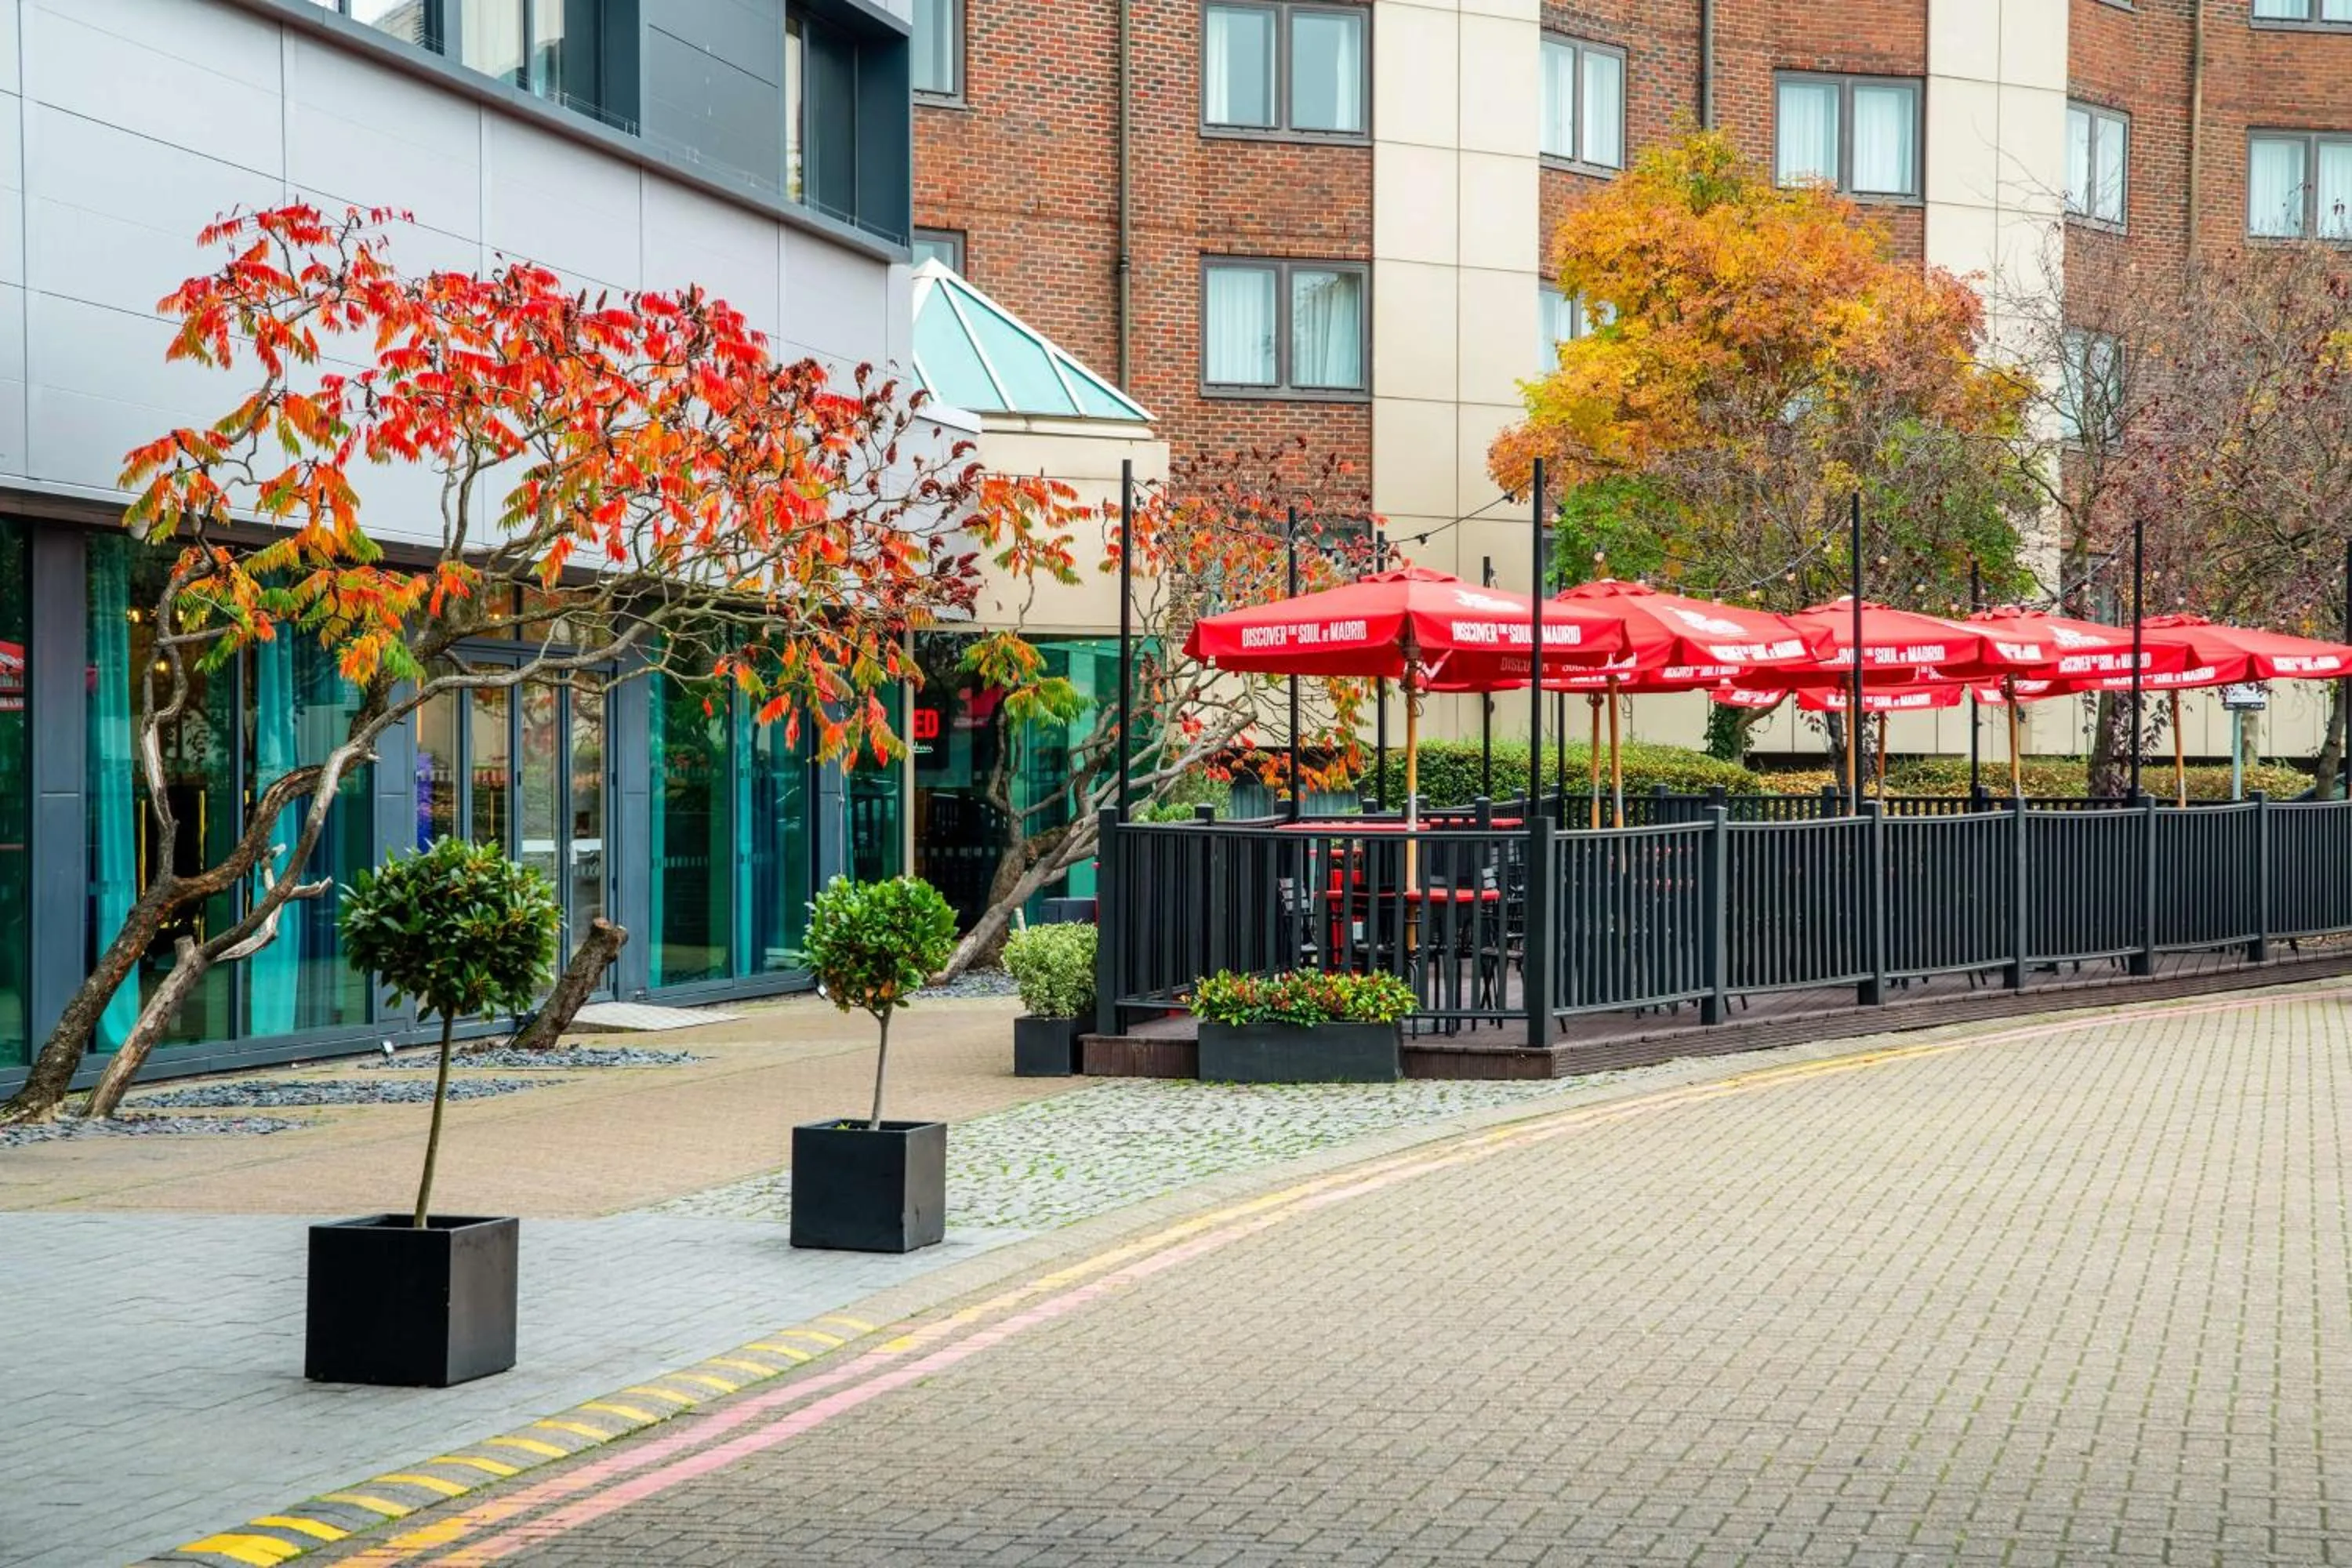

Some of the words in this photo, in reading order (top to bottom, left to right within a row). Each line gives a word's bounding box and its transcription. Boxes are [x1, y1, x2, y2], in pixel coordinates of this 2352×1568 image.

[1242, 625, 1287, 648] DISCOVER
[1298, 622, 1321, 644] SOUL
[1330, 620, 1367, 641] MADRID
[1451, 621, 1499, 644] DISCOVER
[1508, 623, 1535, 644] SOUL
[1542, 625, 1581, 645] MADRID
[1875, 647, 1899, 664] SOUL
[1907, 645, 1945, 662] MADRID
[913, 709, 939, 739] ED
